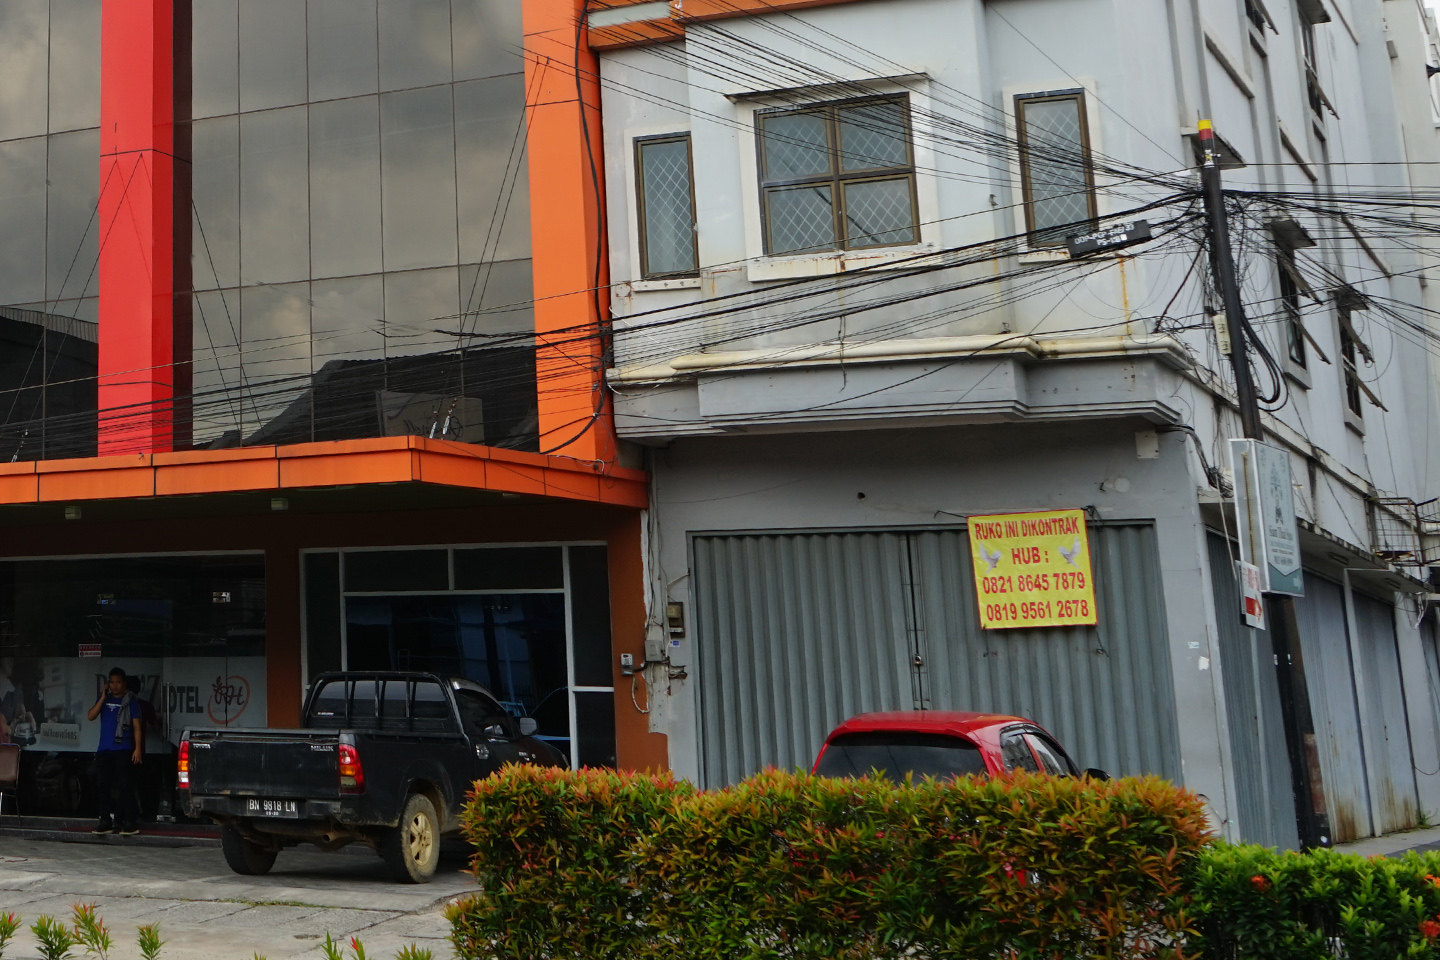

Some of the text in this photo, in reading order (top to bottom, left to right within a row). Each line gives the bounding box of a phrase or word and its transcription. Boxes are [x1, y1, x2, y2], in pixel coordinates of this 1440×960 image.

[974, 516, 1080, 540] RUKO INI DIKONTRAK
[1011, 546, 1041, 565] HUB
[982, 572, 1086, 594] 0821 8645 7879
[986, 599, 1089, 622] 0819 9561 2678
[249, 799, 296, 812] BN 9818 LN
